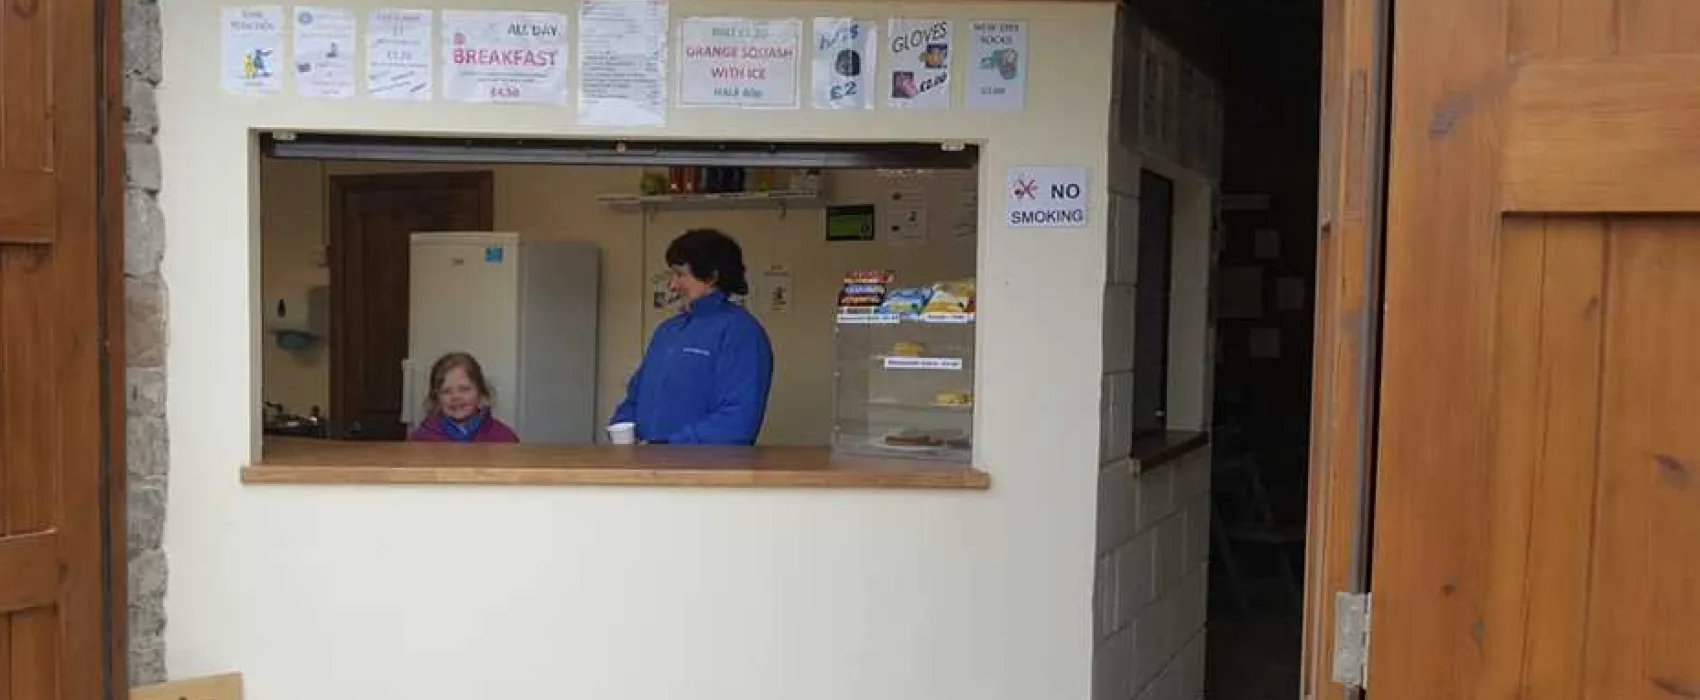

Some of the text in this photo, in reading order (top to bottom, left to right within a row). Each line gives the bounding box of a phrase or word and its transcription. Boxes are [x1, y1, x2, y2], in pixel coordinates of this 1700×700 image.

[891, 20, 948, 53] GLOVES
[453, 47, 558, 67] BREAKFAST
[711, 65, 744, 79] WITH
[830, 80, 858, 100] £2
[1051, 183, 1081, 200] NO
[1010, 208, 1084, 225] SMOKING
